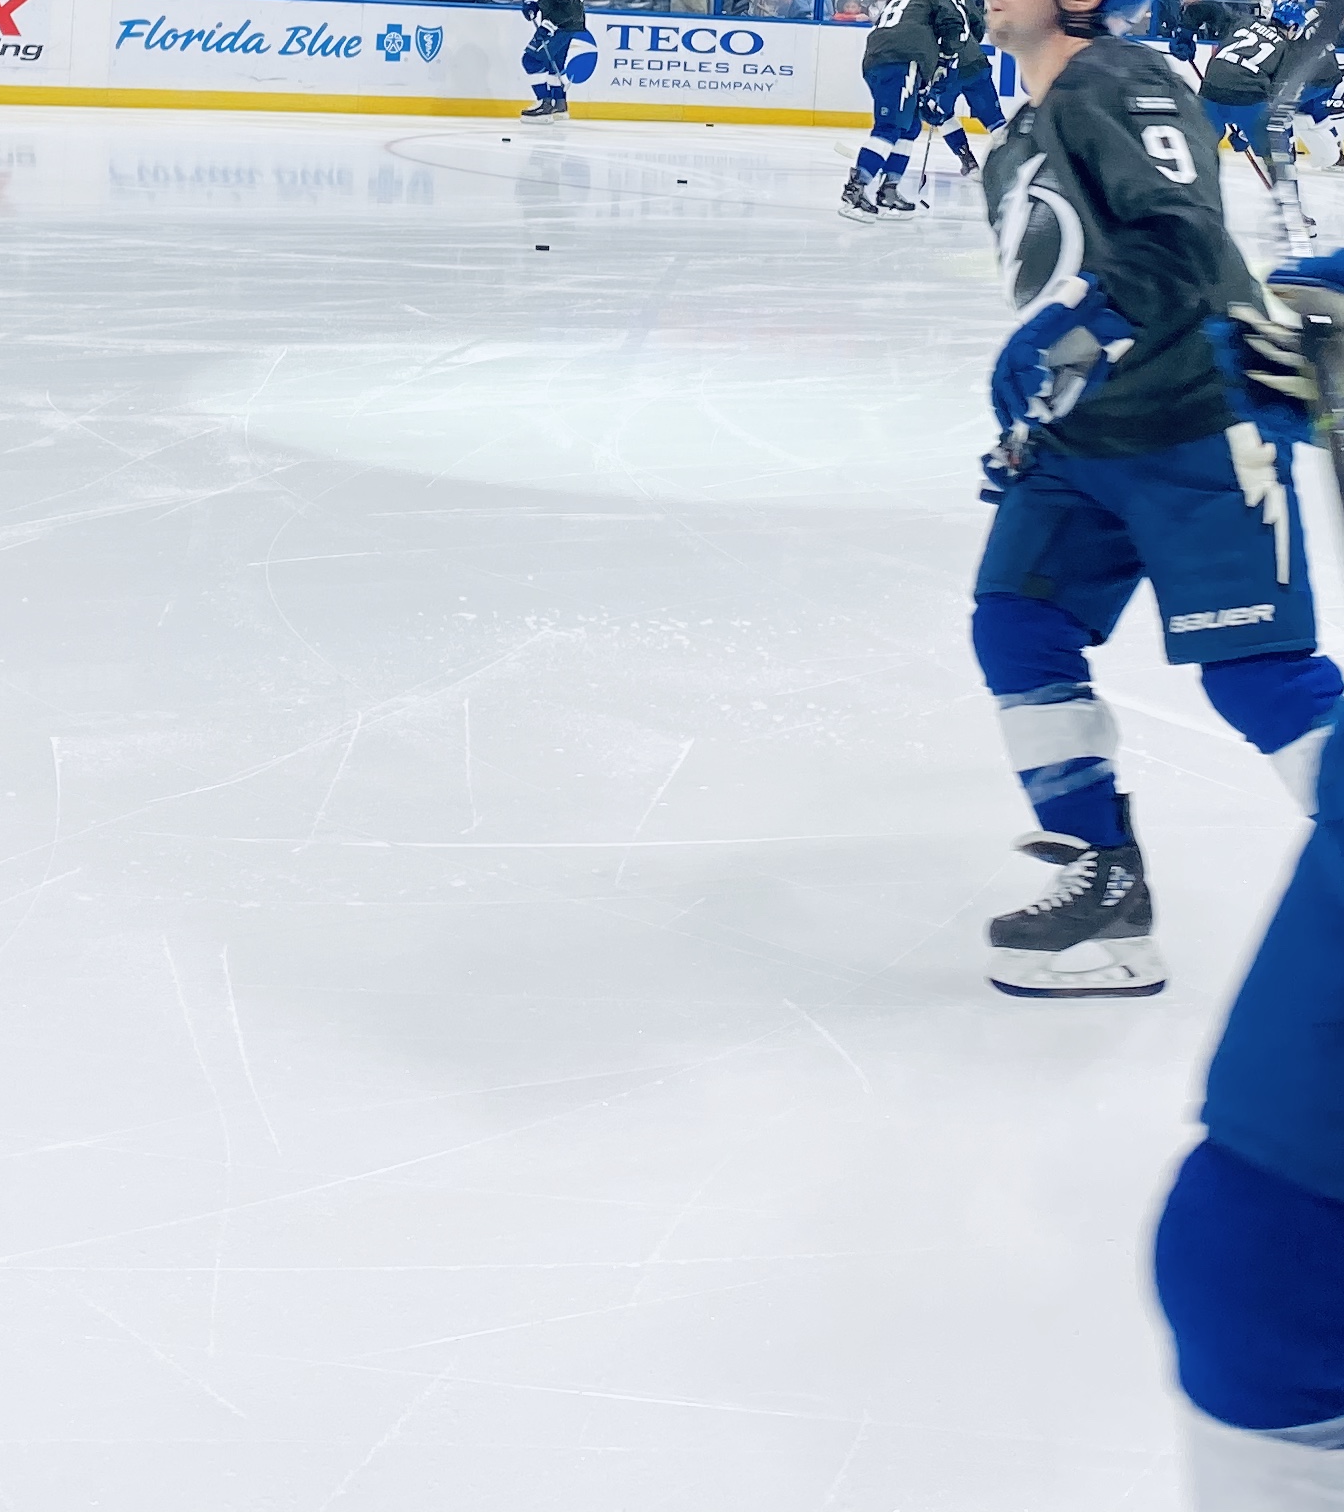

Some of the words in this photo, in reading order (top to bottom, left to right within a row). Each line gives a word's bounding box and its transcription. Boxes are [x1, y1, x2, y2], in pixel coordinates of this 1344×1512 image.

[115, 15, 271, 54] Florida
[278, 22, 363, 59] Blue
[607, 24, 764, 56] TECO
[1250, 21, 1285, 44] POINT
[613, 58, 730, 75] PEOPLES
[743, 63, 794, 77] GAS
[1215, 28, 1276, 75] 21
[611, 77, 633, 87] AN
[638, 78, 692, 89] EMERA
[697, 80, 774, 92] COMPANY
[1140, 125, 1198, 185] 9
